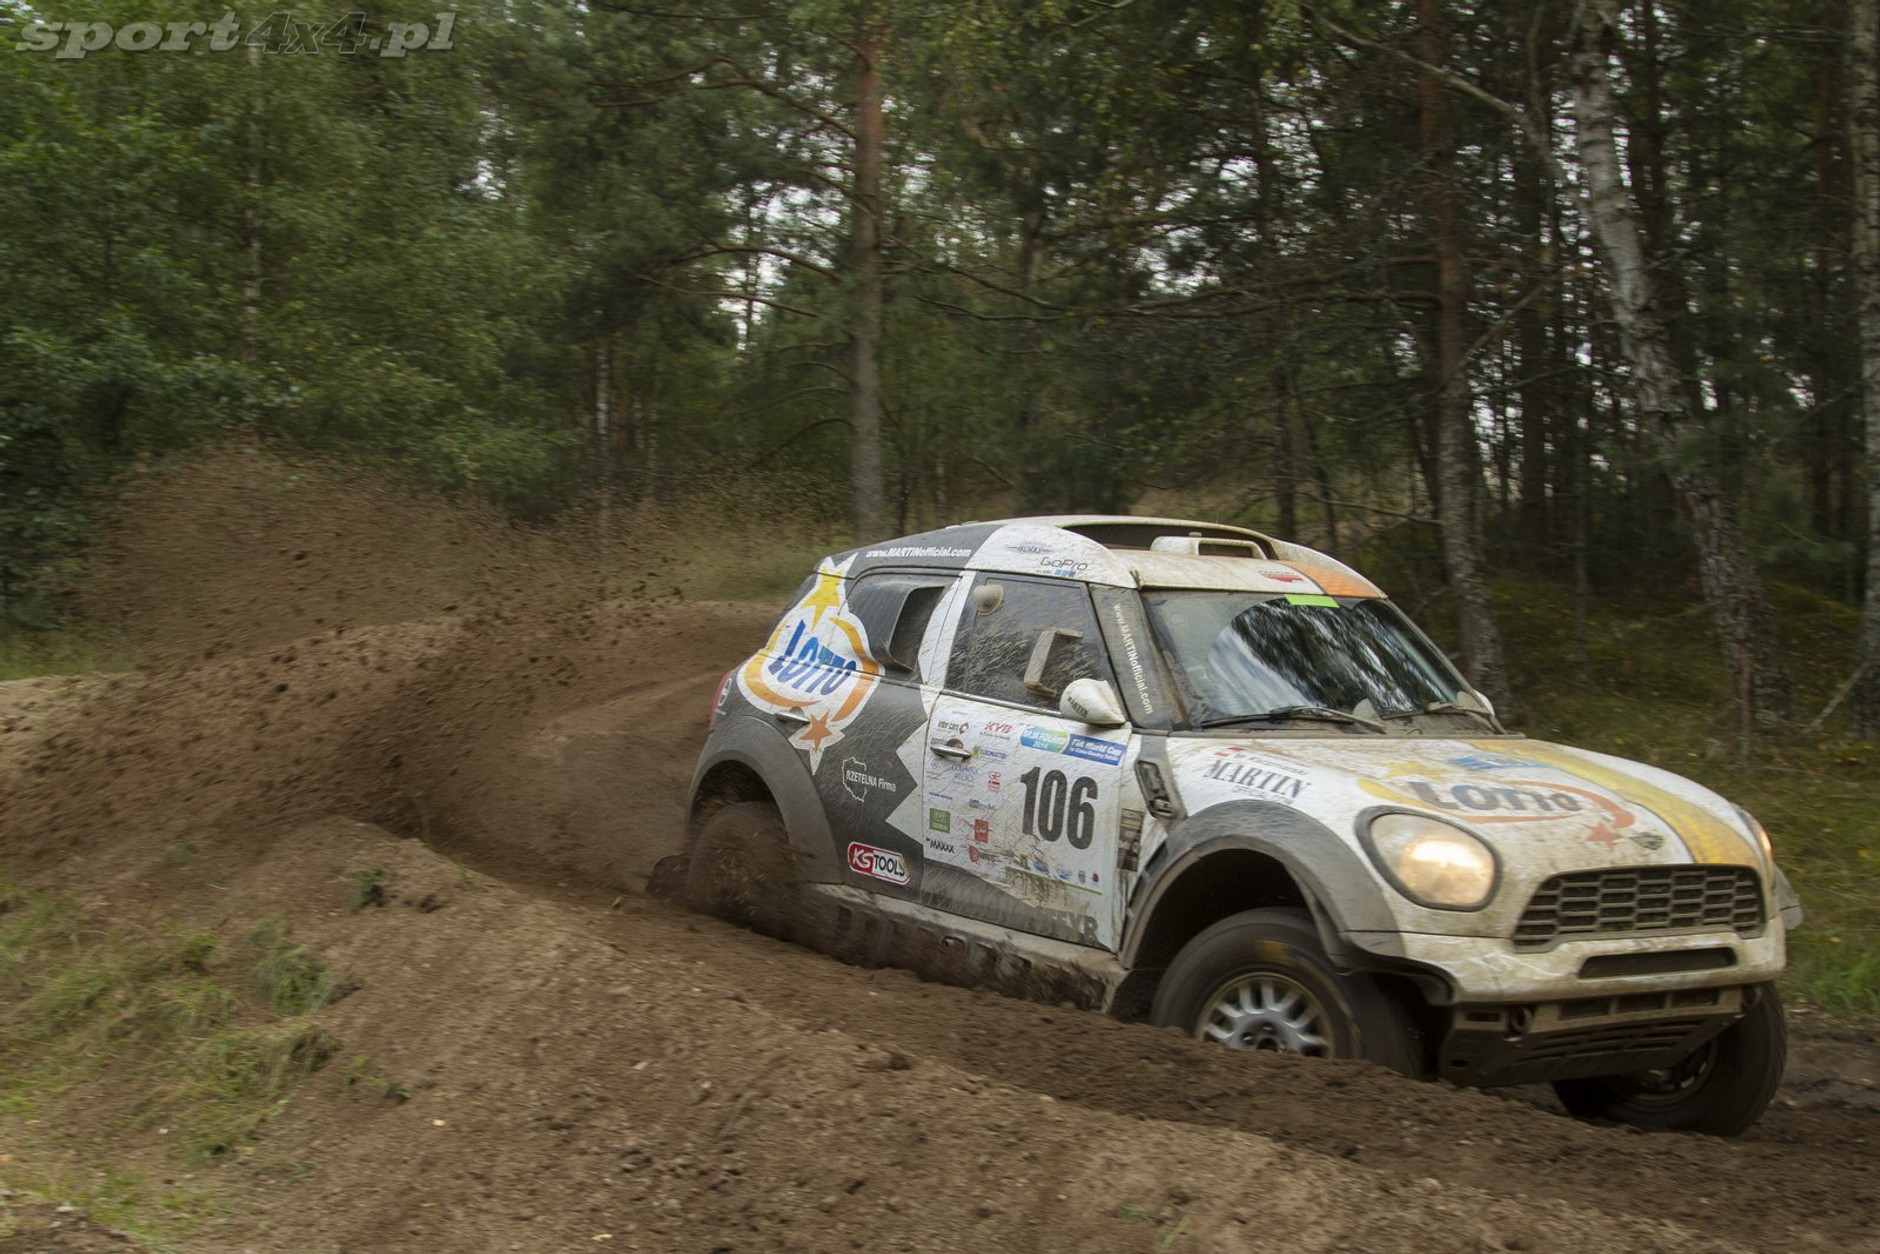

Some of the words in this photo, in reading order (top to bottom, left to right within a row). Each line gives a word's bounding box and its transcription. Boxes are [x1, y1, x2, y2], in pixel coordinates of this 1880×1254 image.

[866, 546, 971, 558] www.MARTINofficial.com
[1040, 556, 1088, 571] GoPro
[768, 619, 857, 696] LOTTO
[1113, 603, 1154, 715] www.MARTINofficial.com
[985, 721, 1013, 734] KYB
[1071, 738, 1085, 748] FIA
[845, 770, 878, 786] RZETELNA
[878, 777, 897, 792] Firma
[1203, 760, 1312, 798] MARTIN
[1020, 767, 1098, 849] 106
